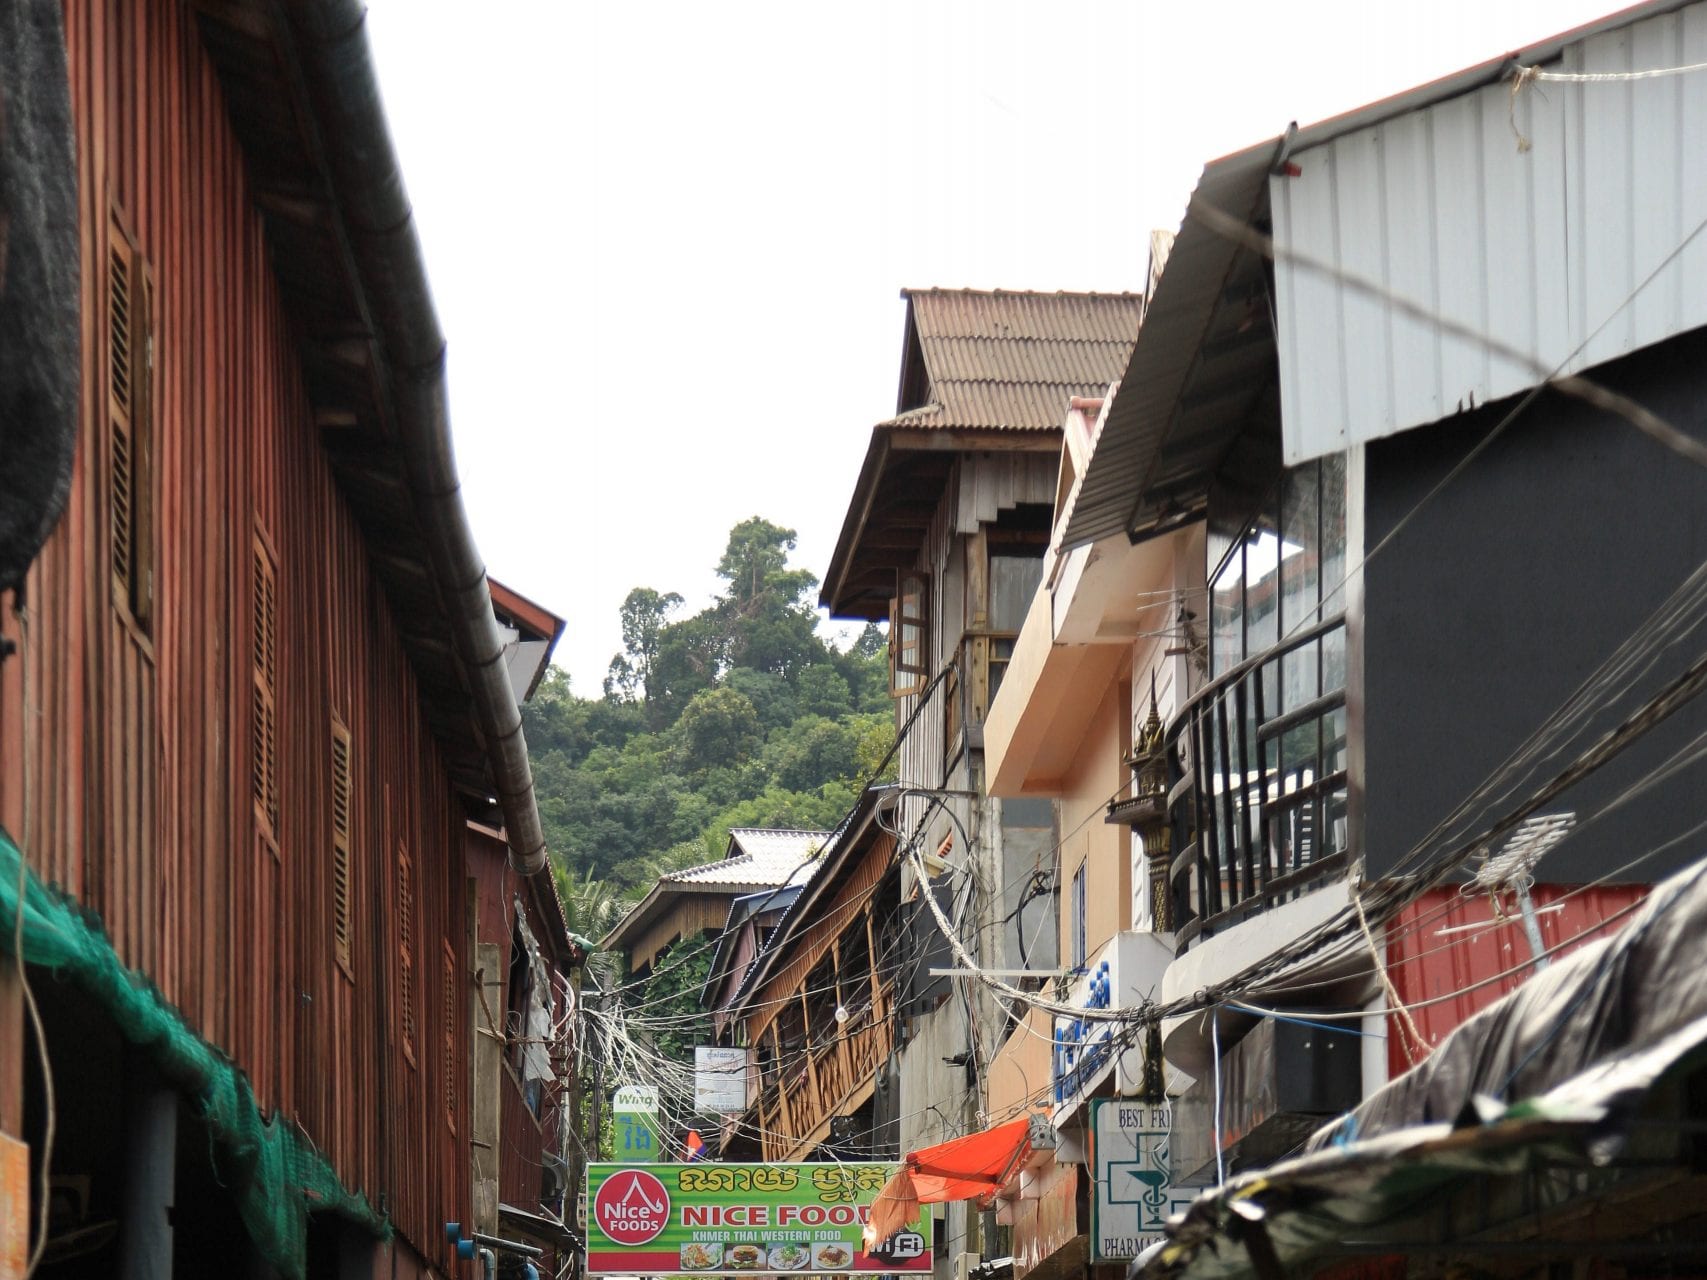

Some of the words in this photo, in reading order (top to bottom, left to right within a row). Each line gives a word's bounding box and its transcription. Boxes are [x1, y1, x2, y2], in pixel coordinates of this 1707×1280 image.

[1119, 1108, 1144, 1128] BEST
[604, 1202, 650, 1219] Nice
[682, 1206, 768, 1226] NICE
[610, 1220, 659, 1231] FOODS
[692, 1231, 730, 1242] KHMER
[733, 1231, 757, 1241] THAI
[761, 1230, 811, 1241] WESTERN
[814, 1230, 842, 1241] FOOD
